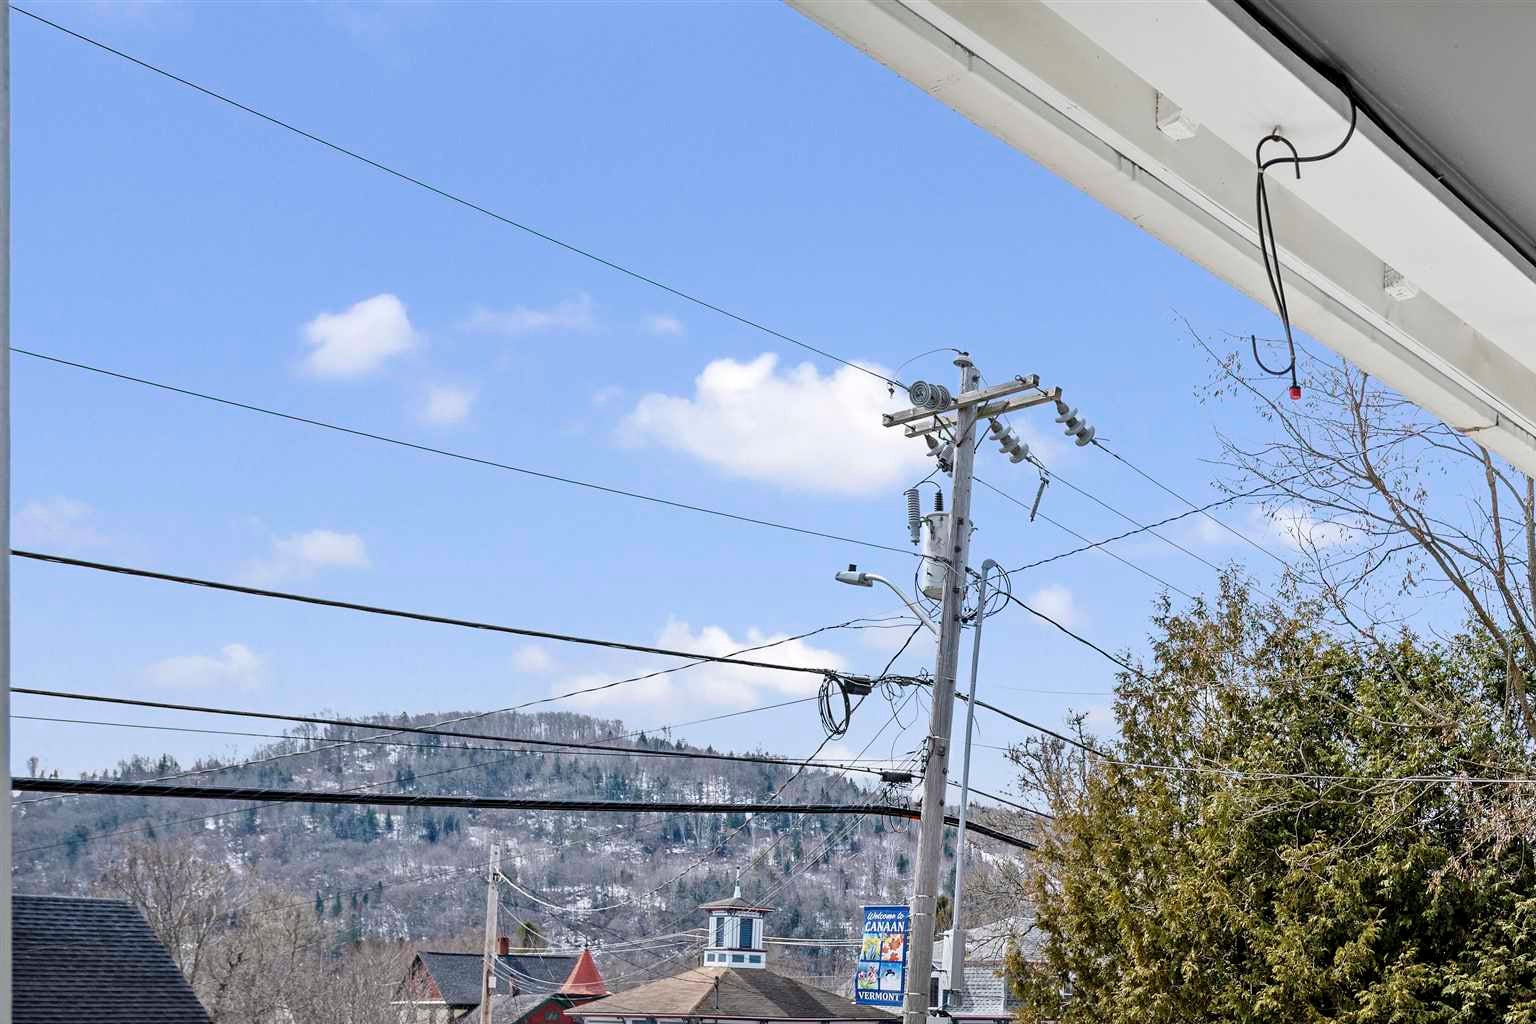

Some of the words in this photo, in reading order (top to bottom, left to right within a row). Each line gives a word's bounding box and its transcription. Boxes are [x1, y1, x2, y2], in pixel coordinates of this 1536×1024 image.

[867, 912, 896, 921] Welcome
[897, 912, 905, 920] to
[865, 921, 905, 932] CANAAN
[858, 991, 900, 1001] VERMONT
